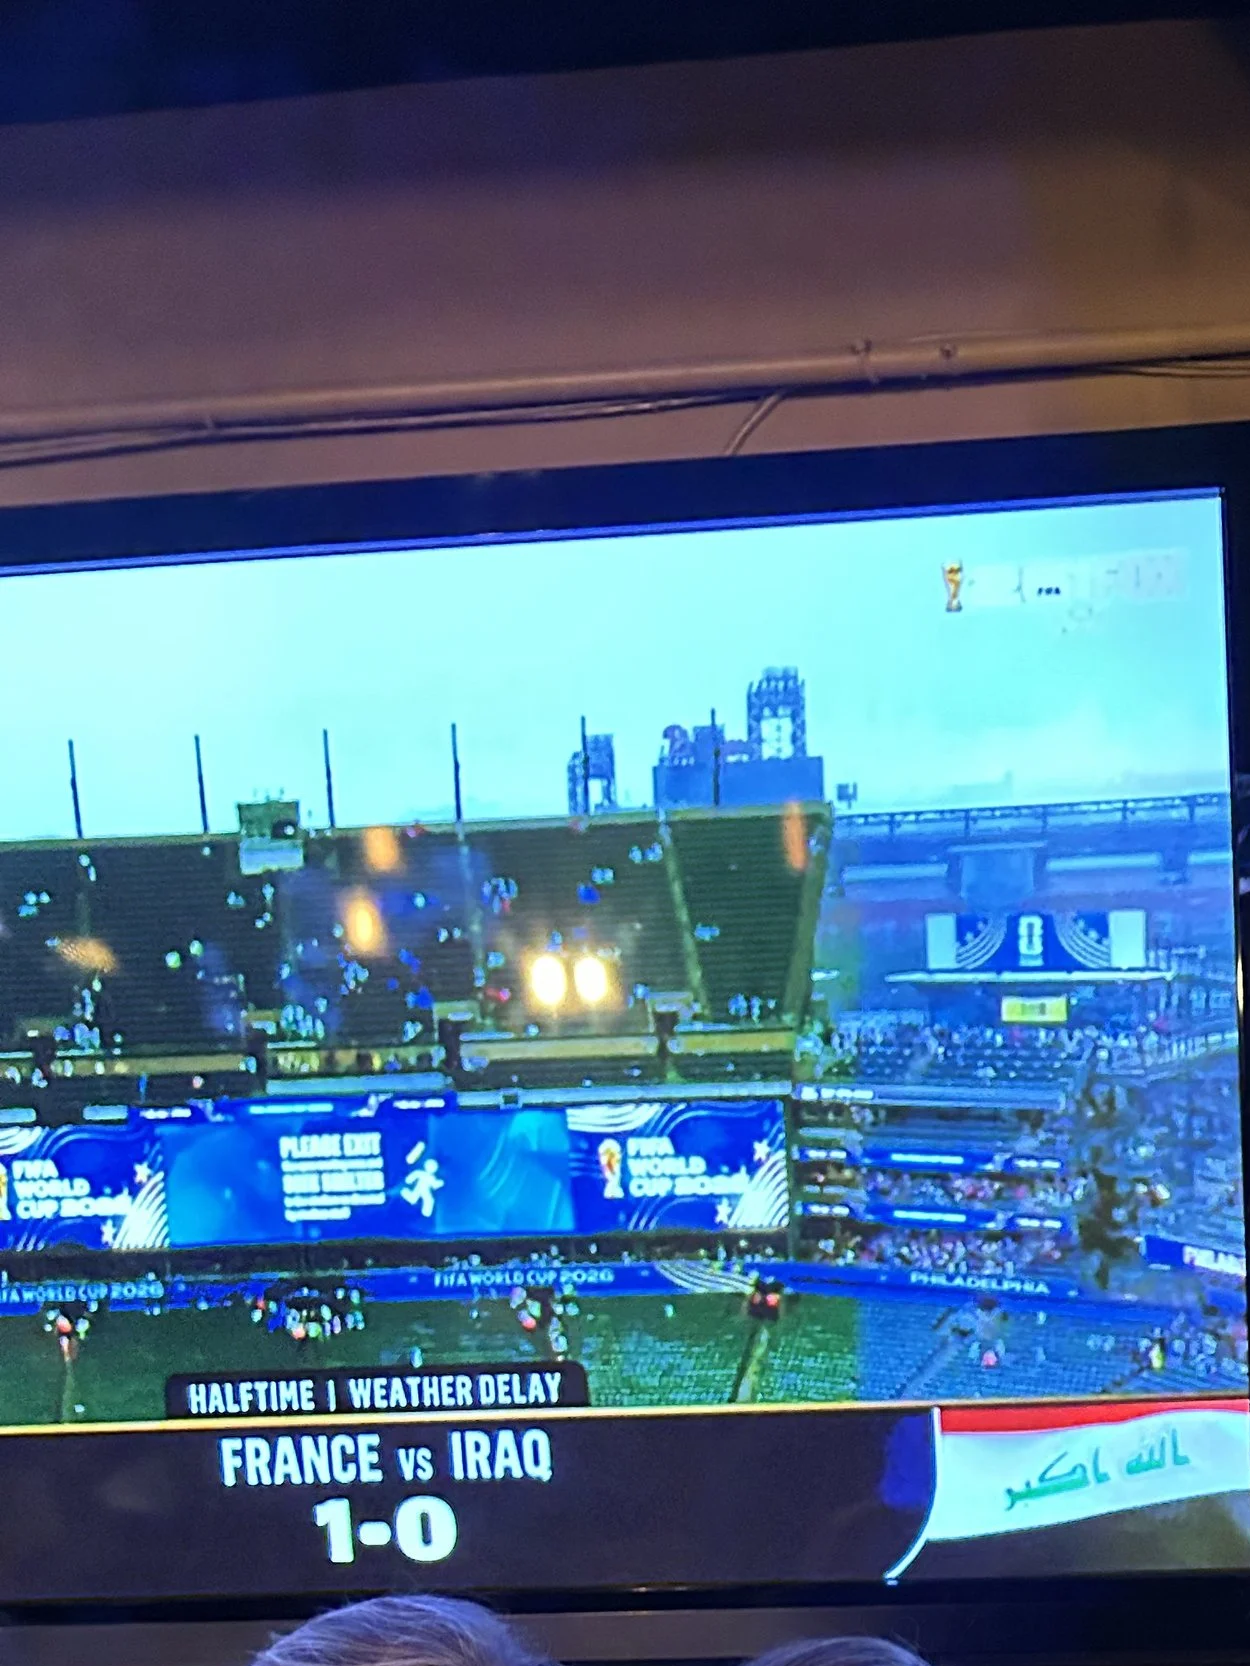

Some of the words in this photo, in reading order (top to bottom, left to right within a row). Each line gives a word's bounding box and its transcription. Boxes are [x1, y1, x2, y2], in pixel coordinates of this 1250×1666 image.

[628, 1155, 707, 1177] WORLD
[469, 1269, 524, 1285] WORLD
[526, 1269, 557, 1285] CUP
[910, 1271, 1051, 1296] PHILADELPHIA
[188, 1379, 316, 1415] HALFTIME
[349, 1374, 473, 1411] WEATHER
[478, 1371, 563, 1405] DELAY
[219, 1433, 383, 1487] FRANCE
[449, 1429, 553, 1483] IRAQ
[314, 1495, 458, 1564] 1-0
